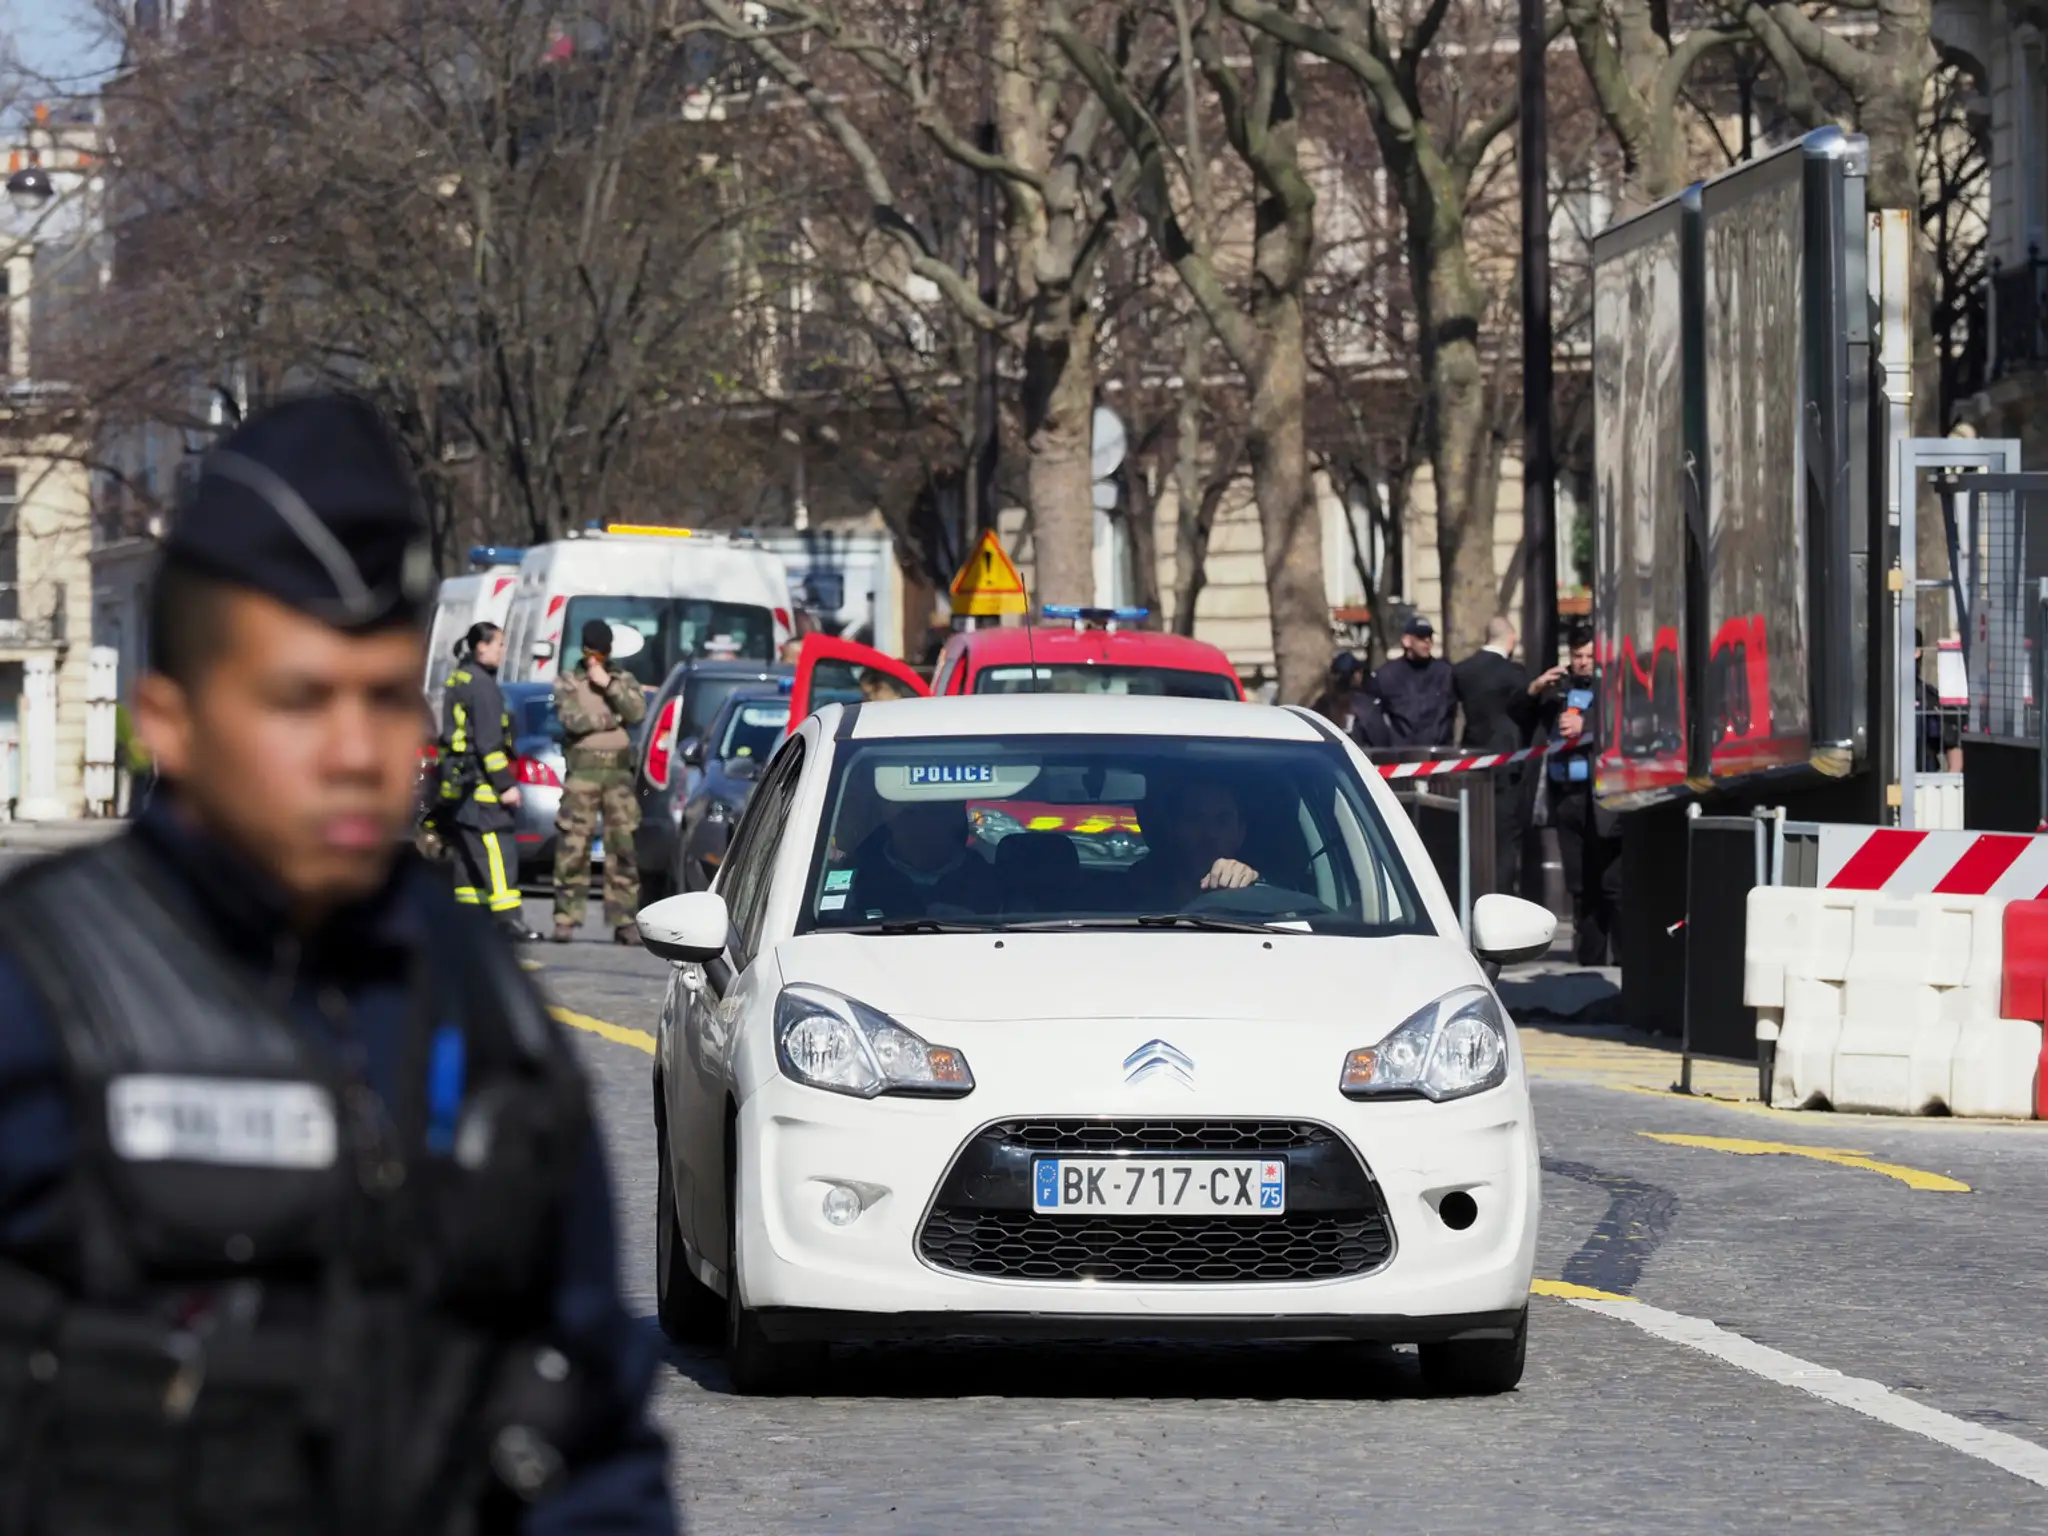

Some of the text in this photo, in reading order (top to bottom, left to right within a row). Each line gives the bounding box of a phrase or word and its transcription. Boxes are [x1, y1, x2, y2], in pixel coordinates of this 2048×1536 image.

[912, 766, 990, 783] POLICE
[1043, 1166, 1281, 1206] F BK-717-CX 75
